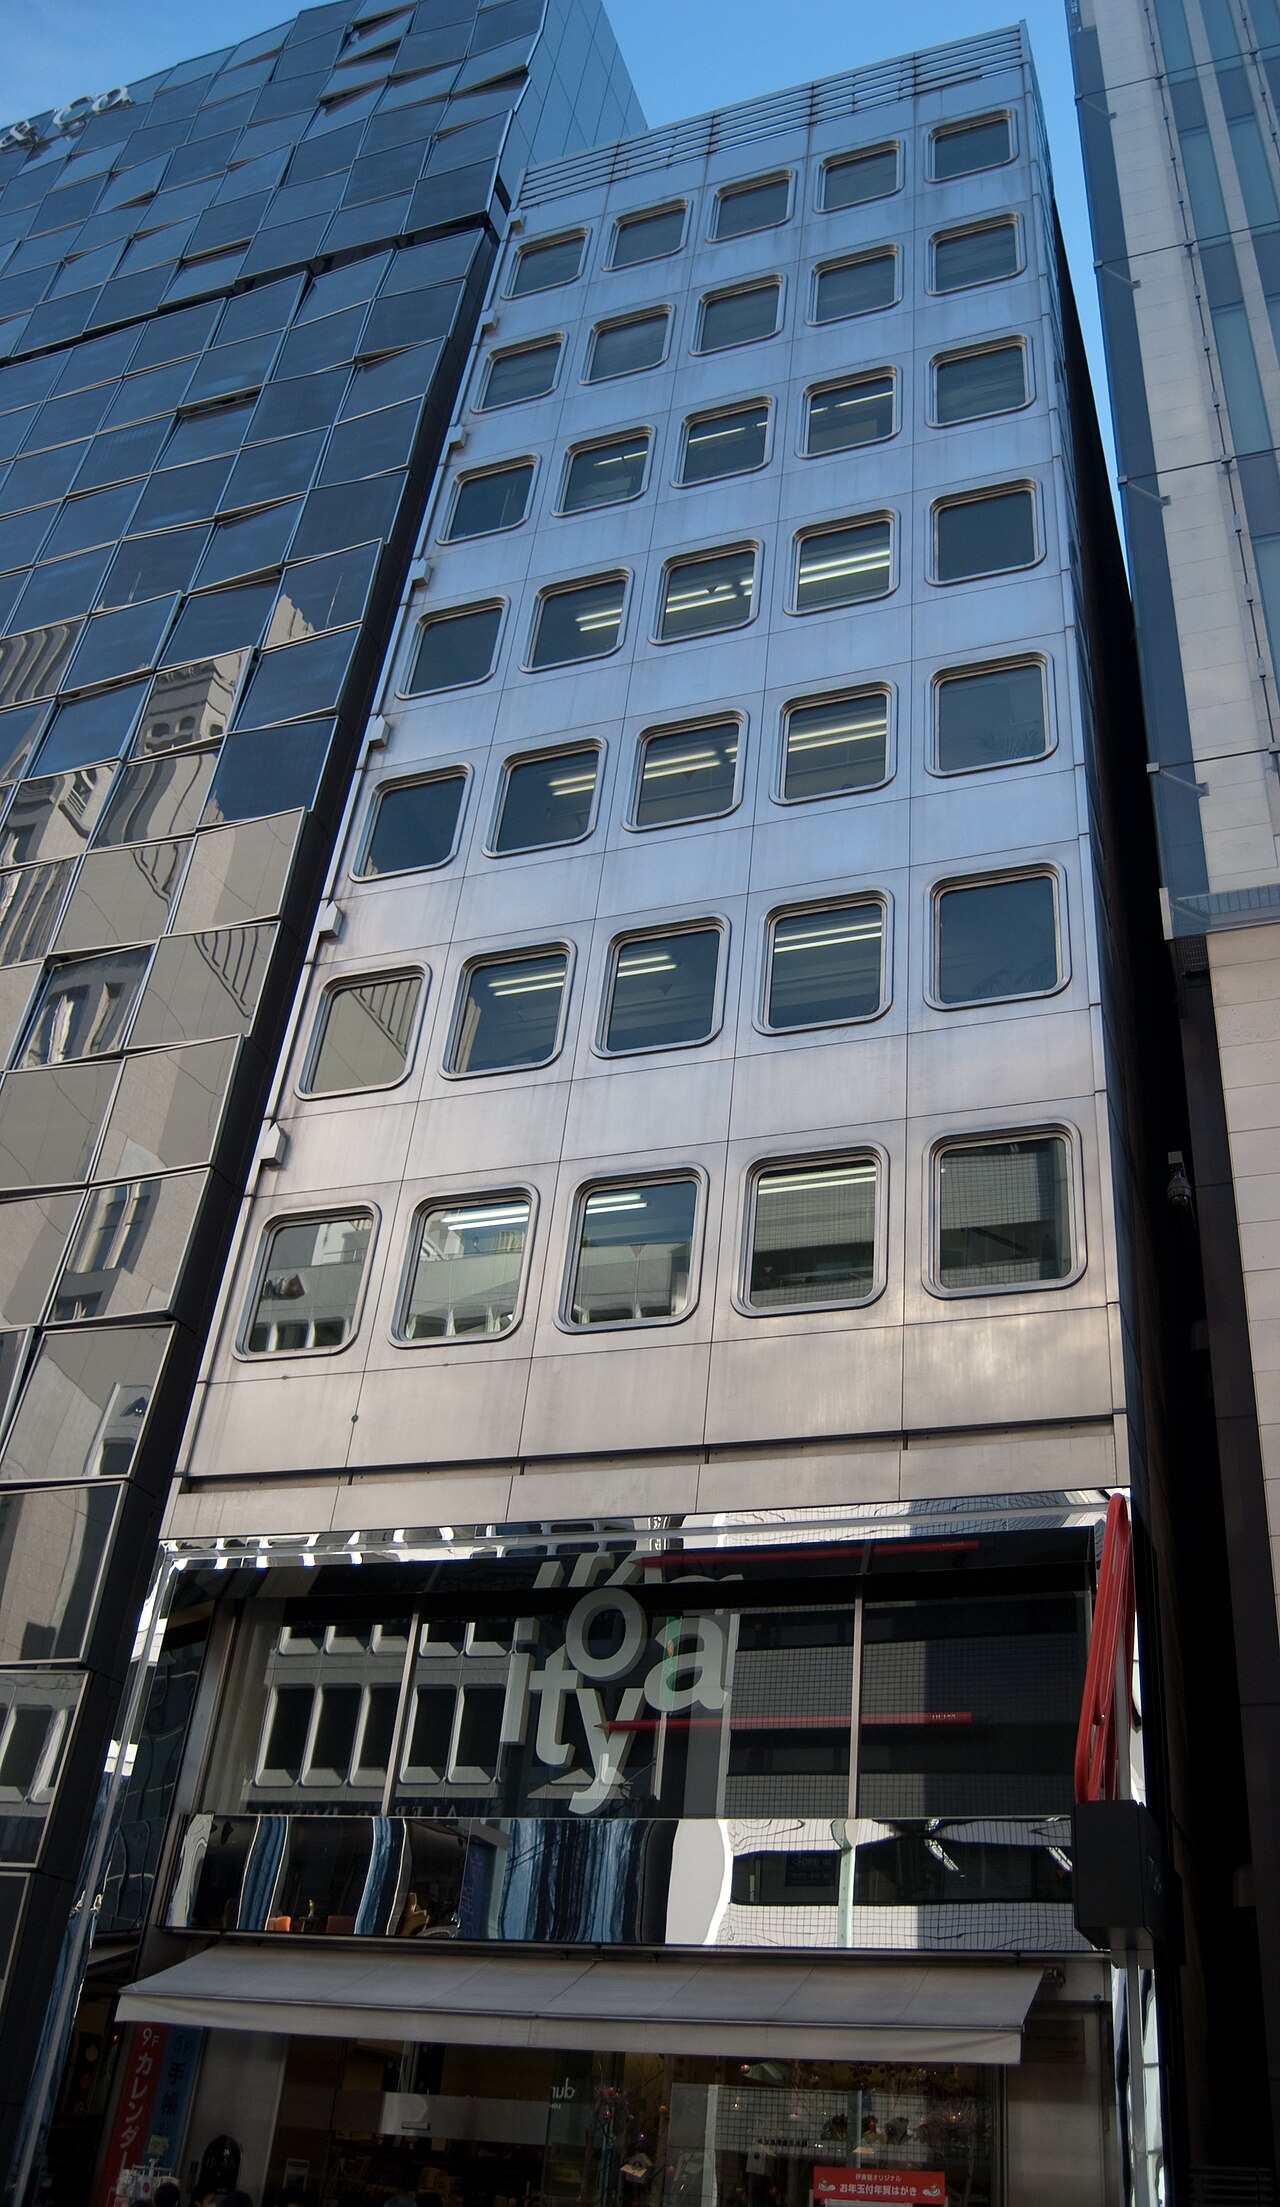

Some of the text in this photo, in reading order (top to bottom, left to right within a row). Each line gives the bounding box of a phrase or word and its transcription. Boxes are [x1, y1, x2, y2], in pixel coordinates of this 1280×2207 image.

[174, 2035, 192, 2054] 5F
[119, 2027, 160, 2169] 9F カレンダー
[839, 2183, 918, 2197] お年玉付年賀はがき
